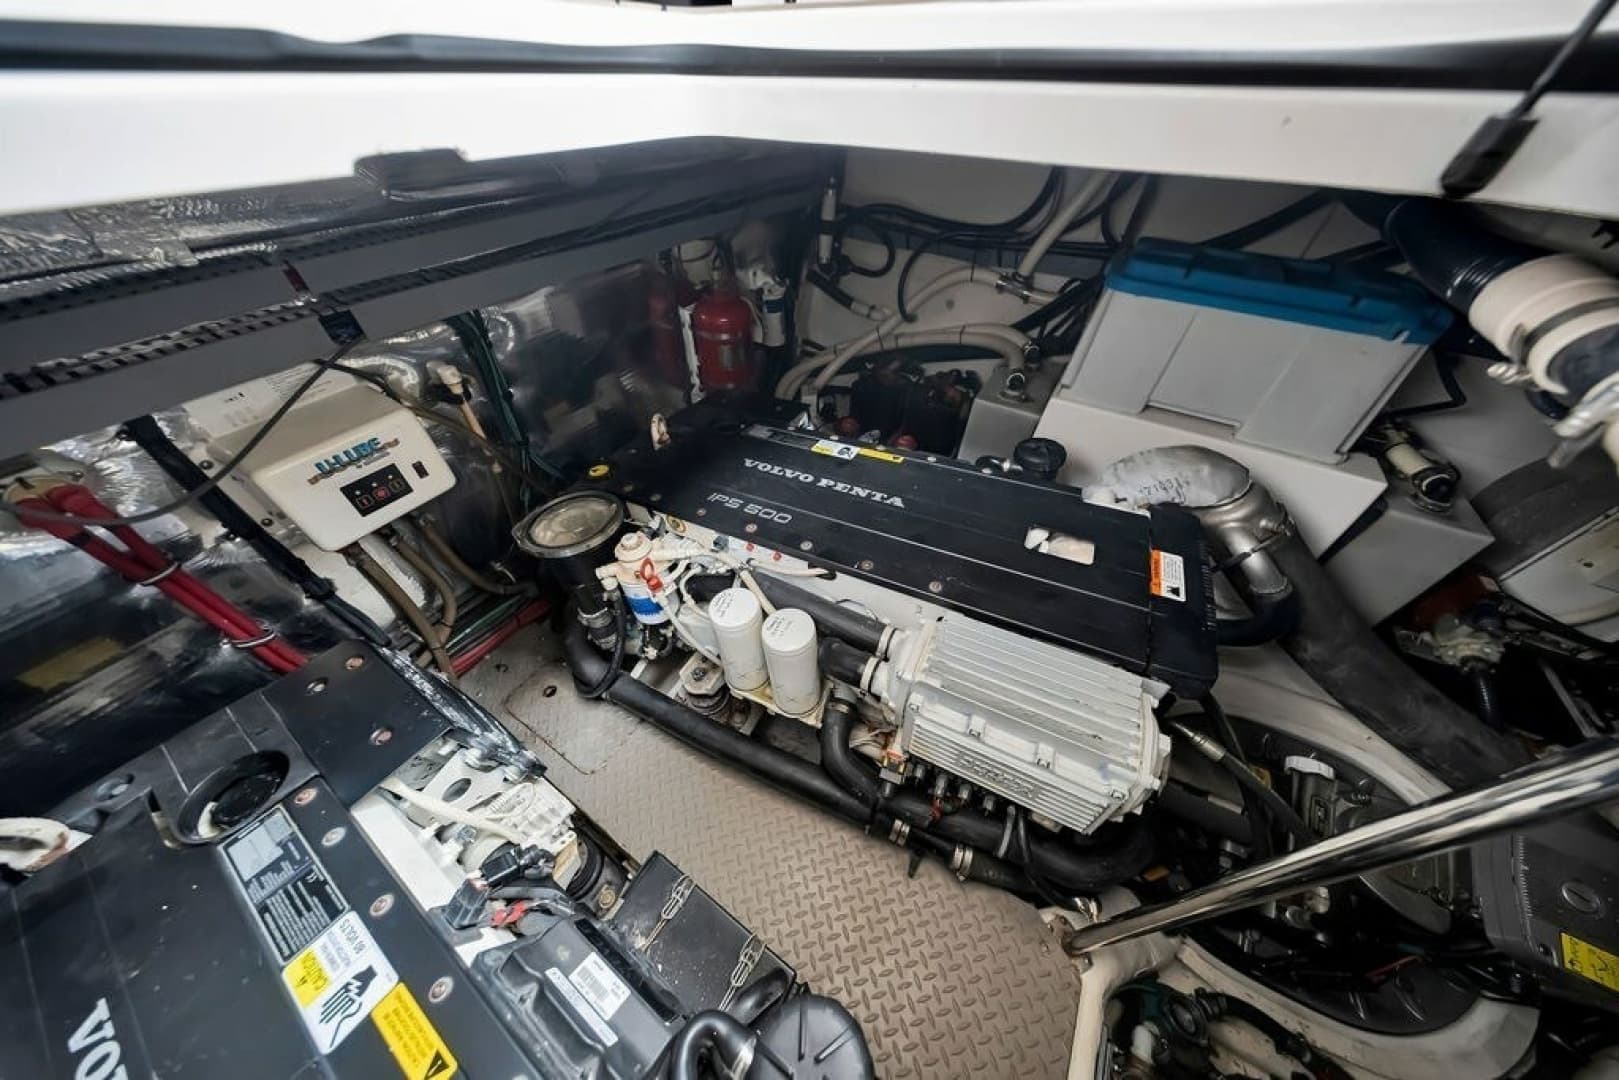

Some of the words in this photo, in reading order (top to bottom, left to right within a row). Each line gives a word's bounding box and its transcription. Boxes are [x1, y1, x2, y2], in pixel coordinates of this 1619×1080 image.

[707, 492, 745, 509] IPS
[744, 503, 793, 524] 500
[743, 457, 815, 483] VOLVO
[816, 477, 905, 508] PENTA
[67, 997, 129, 1080] VO
